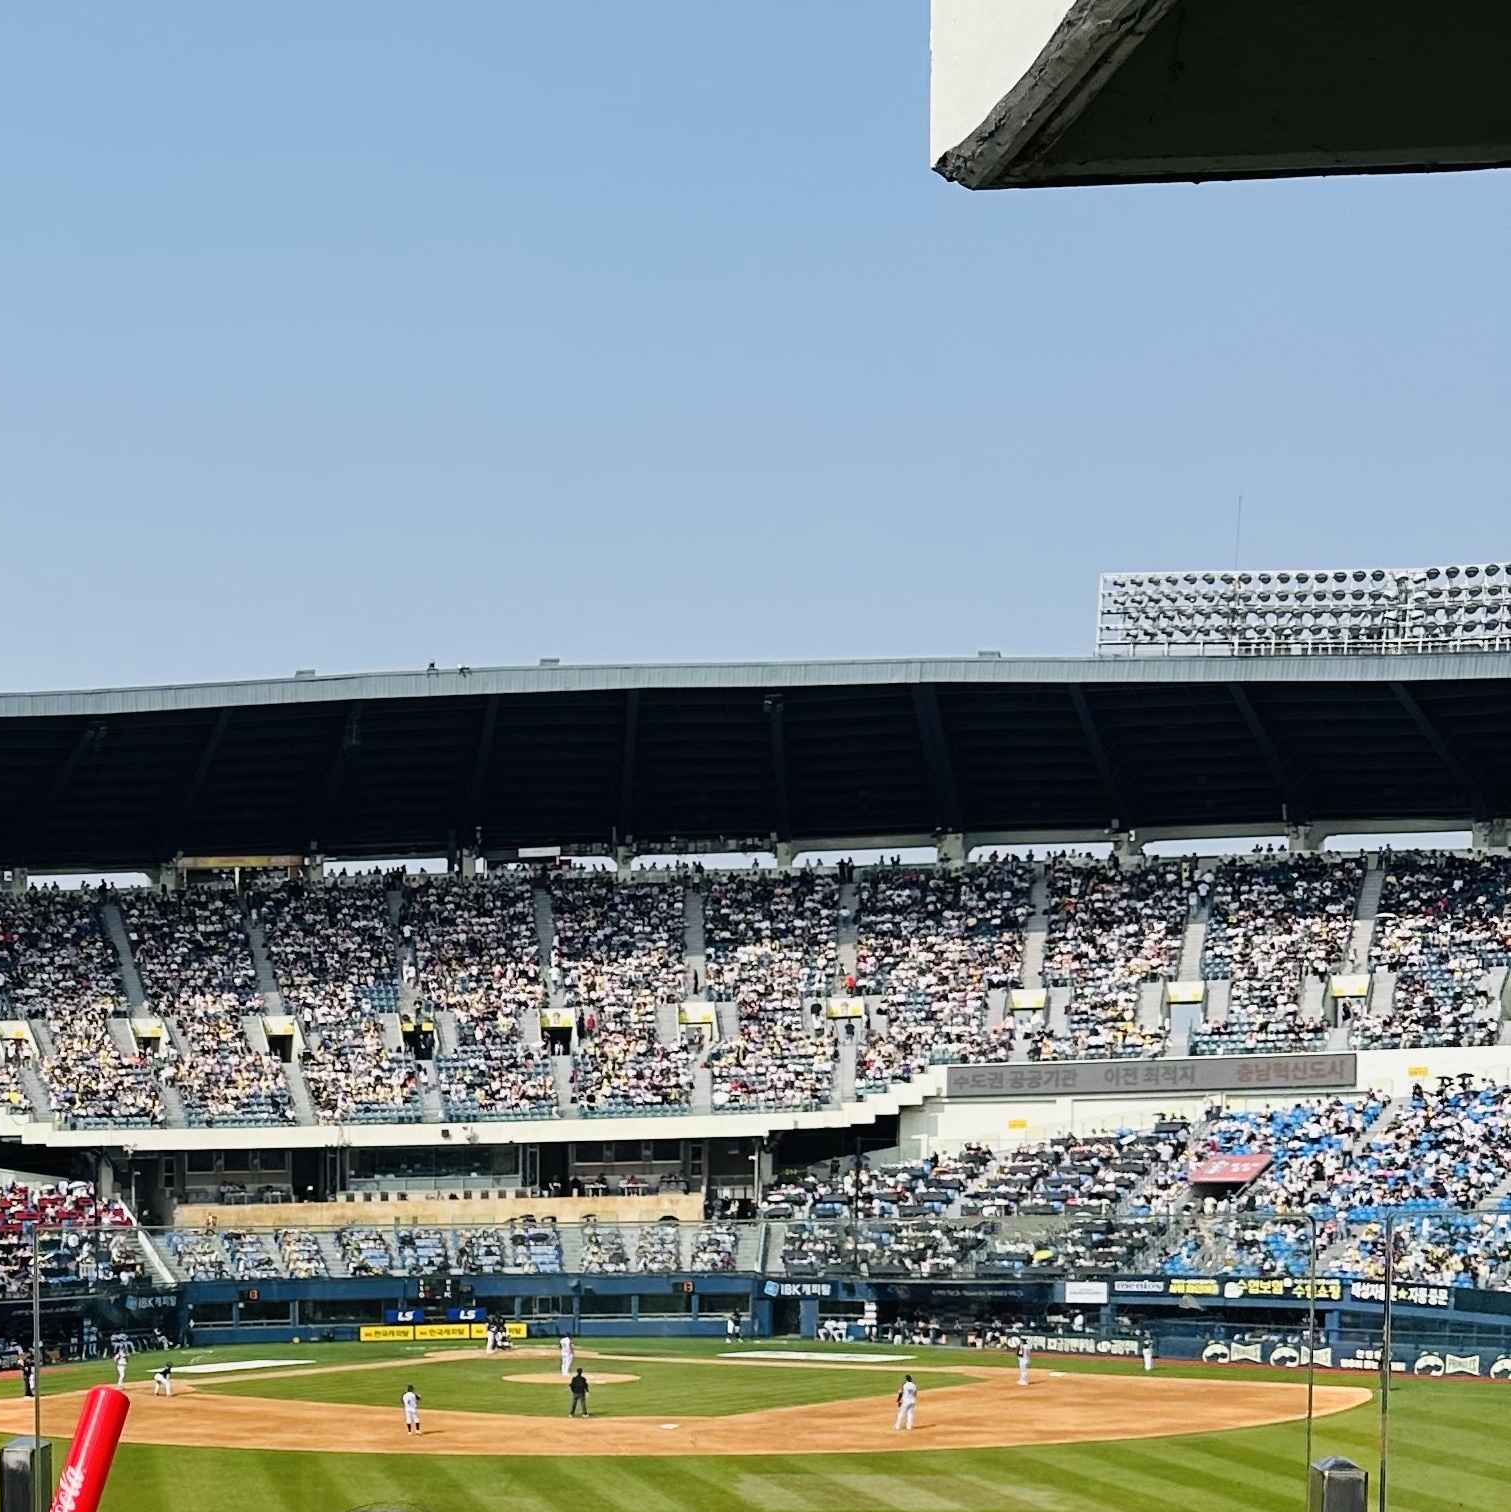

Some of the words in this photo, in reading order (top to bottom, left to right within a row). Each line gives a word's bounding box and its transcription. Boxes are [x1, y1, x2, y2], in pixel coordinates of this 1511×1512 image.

[1009, 1068, 1078, 1089] 공공기관
[1104, 1066, 1137, 1086] 이전
[397, 1310, 415, 1321] LS
[459, 1309, 477, 1320] LS
